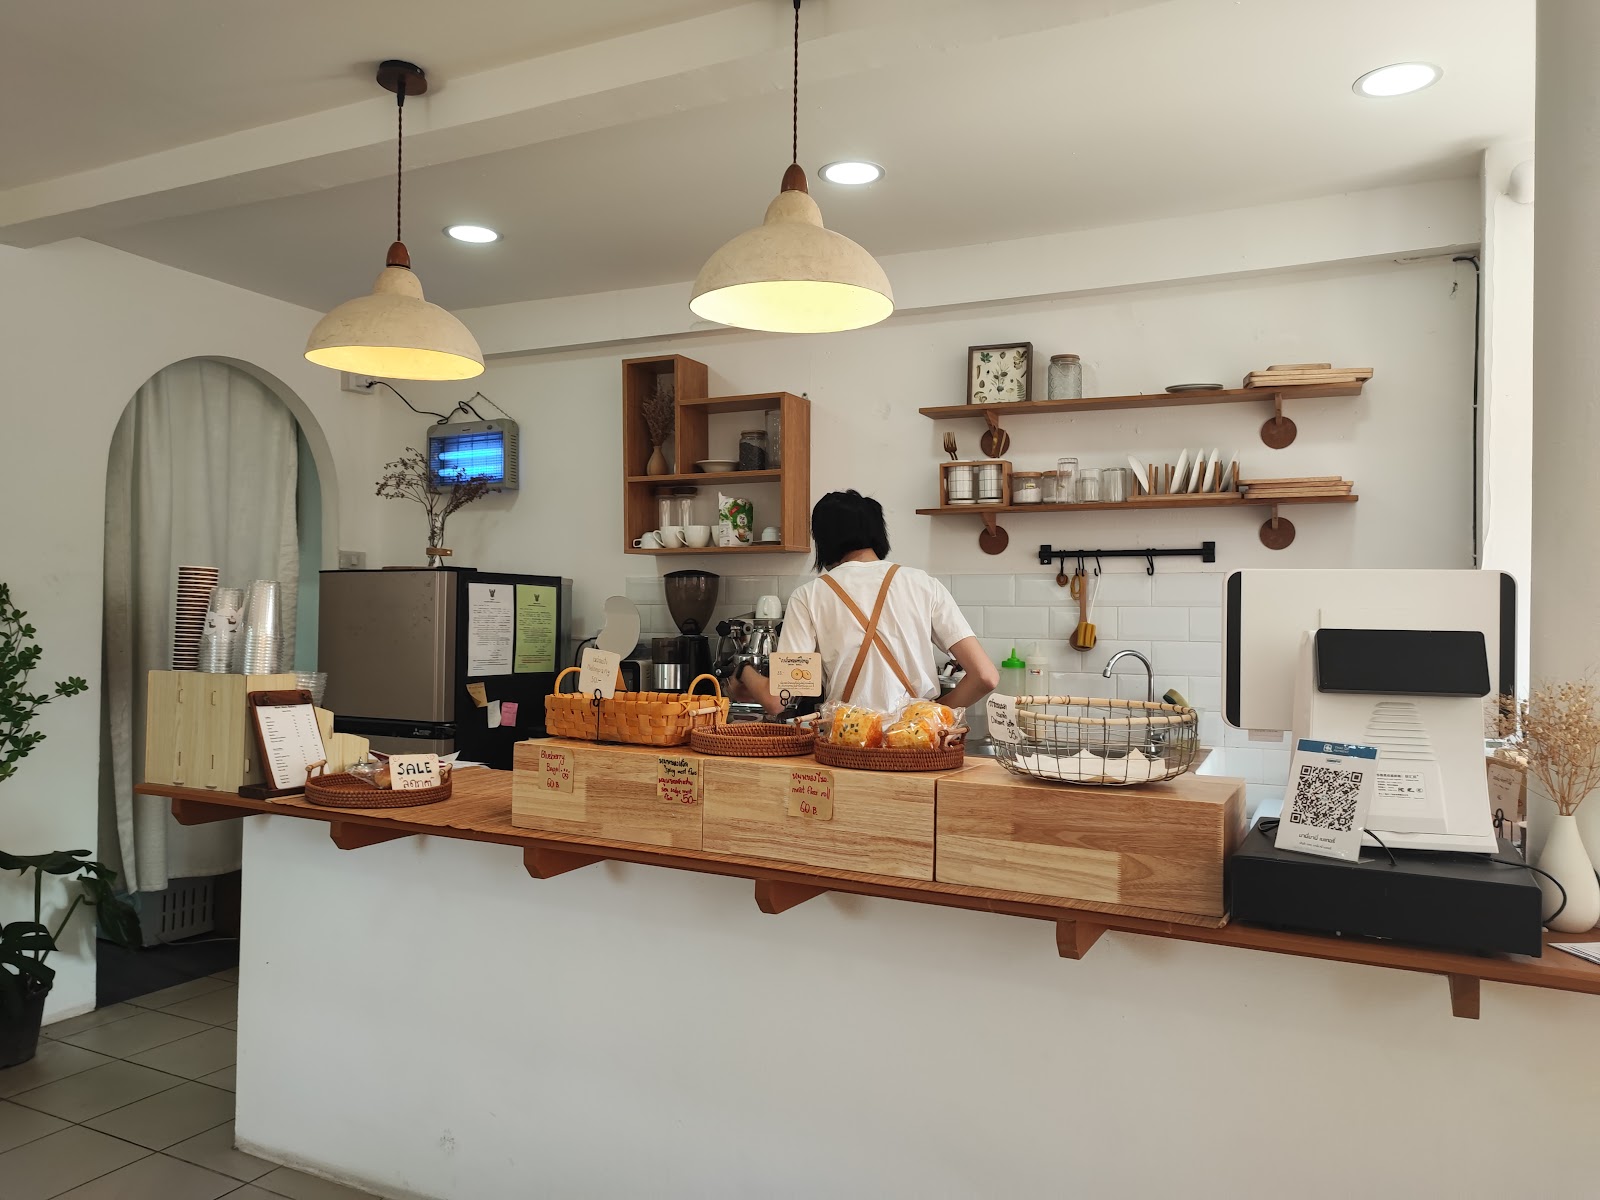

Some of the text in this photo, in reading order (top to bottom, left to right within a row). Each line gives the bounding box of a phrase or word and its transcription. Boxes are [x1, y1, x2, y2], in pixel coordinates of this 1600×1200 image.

[541, 750, 565, 765] Blueberry
[397, 761, 432, 776] SALE
[546, 778, 555, 788] 60
[800, 801, 811, 813] 60
